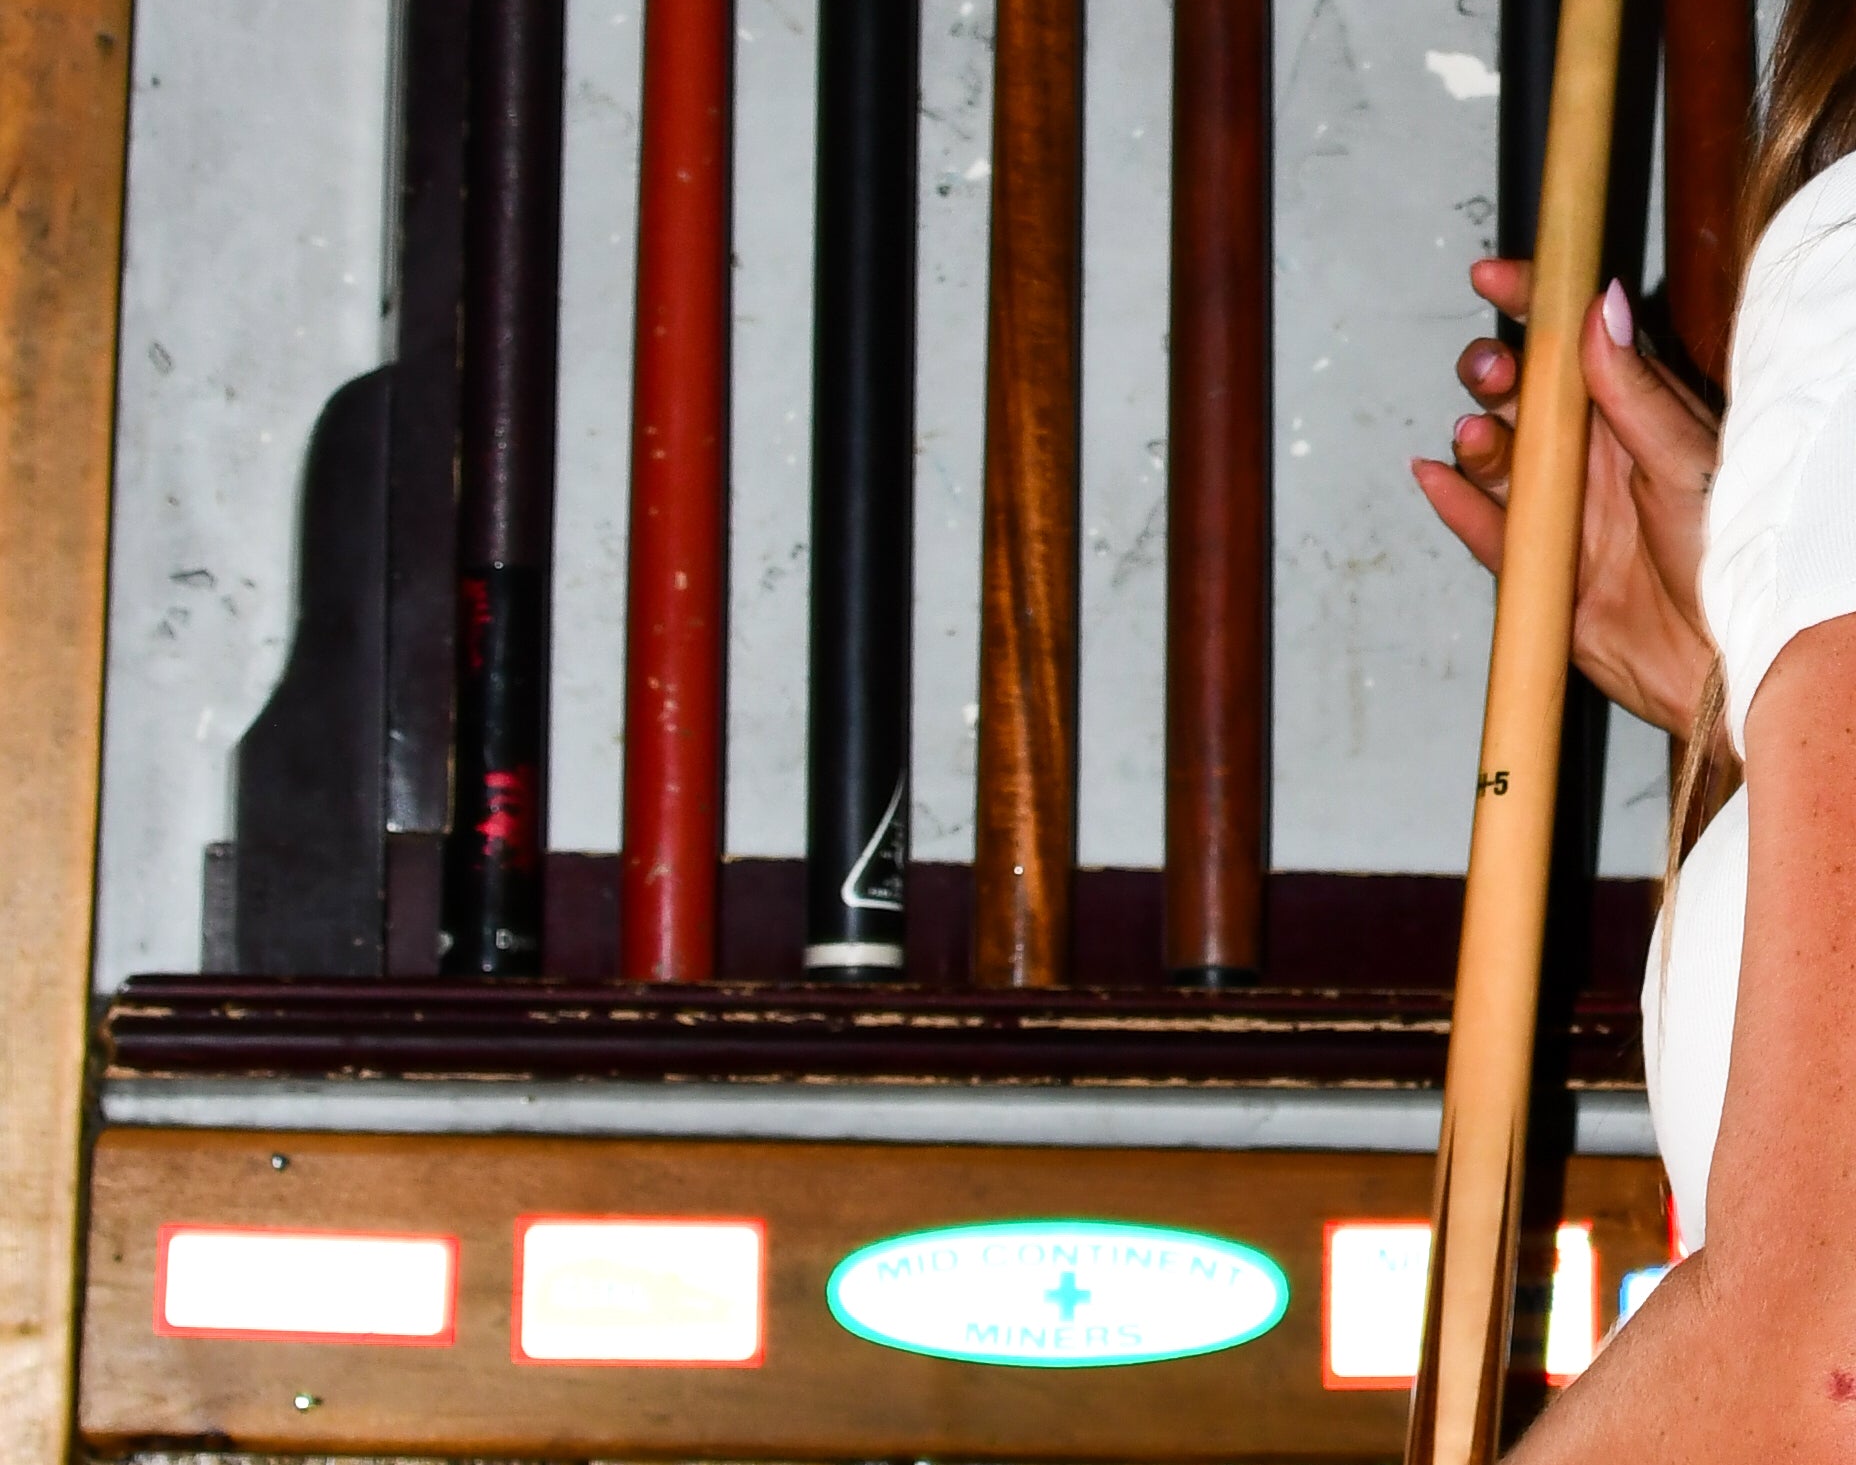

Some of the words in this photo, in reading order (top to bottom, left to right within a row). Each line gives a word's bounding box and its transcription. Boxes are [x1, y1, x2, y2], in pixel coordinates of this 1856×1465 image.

[875, 1247, 960, 1285] MID
[981, 1242, 1247, 1288] CONTINENT
[965, 1321, 1144, 1350] MINERS
